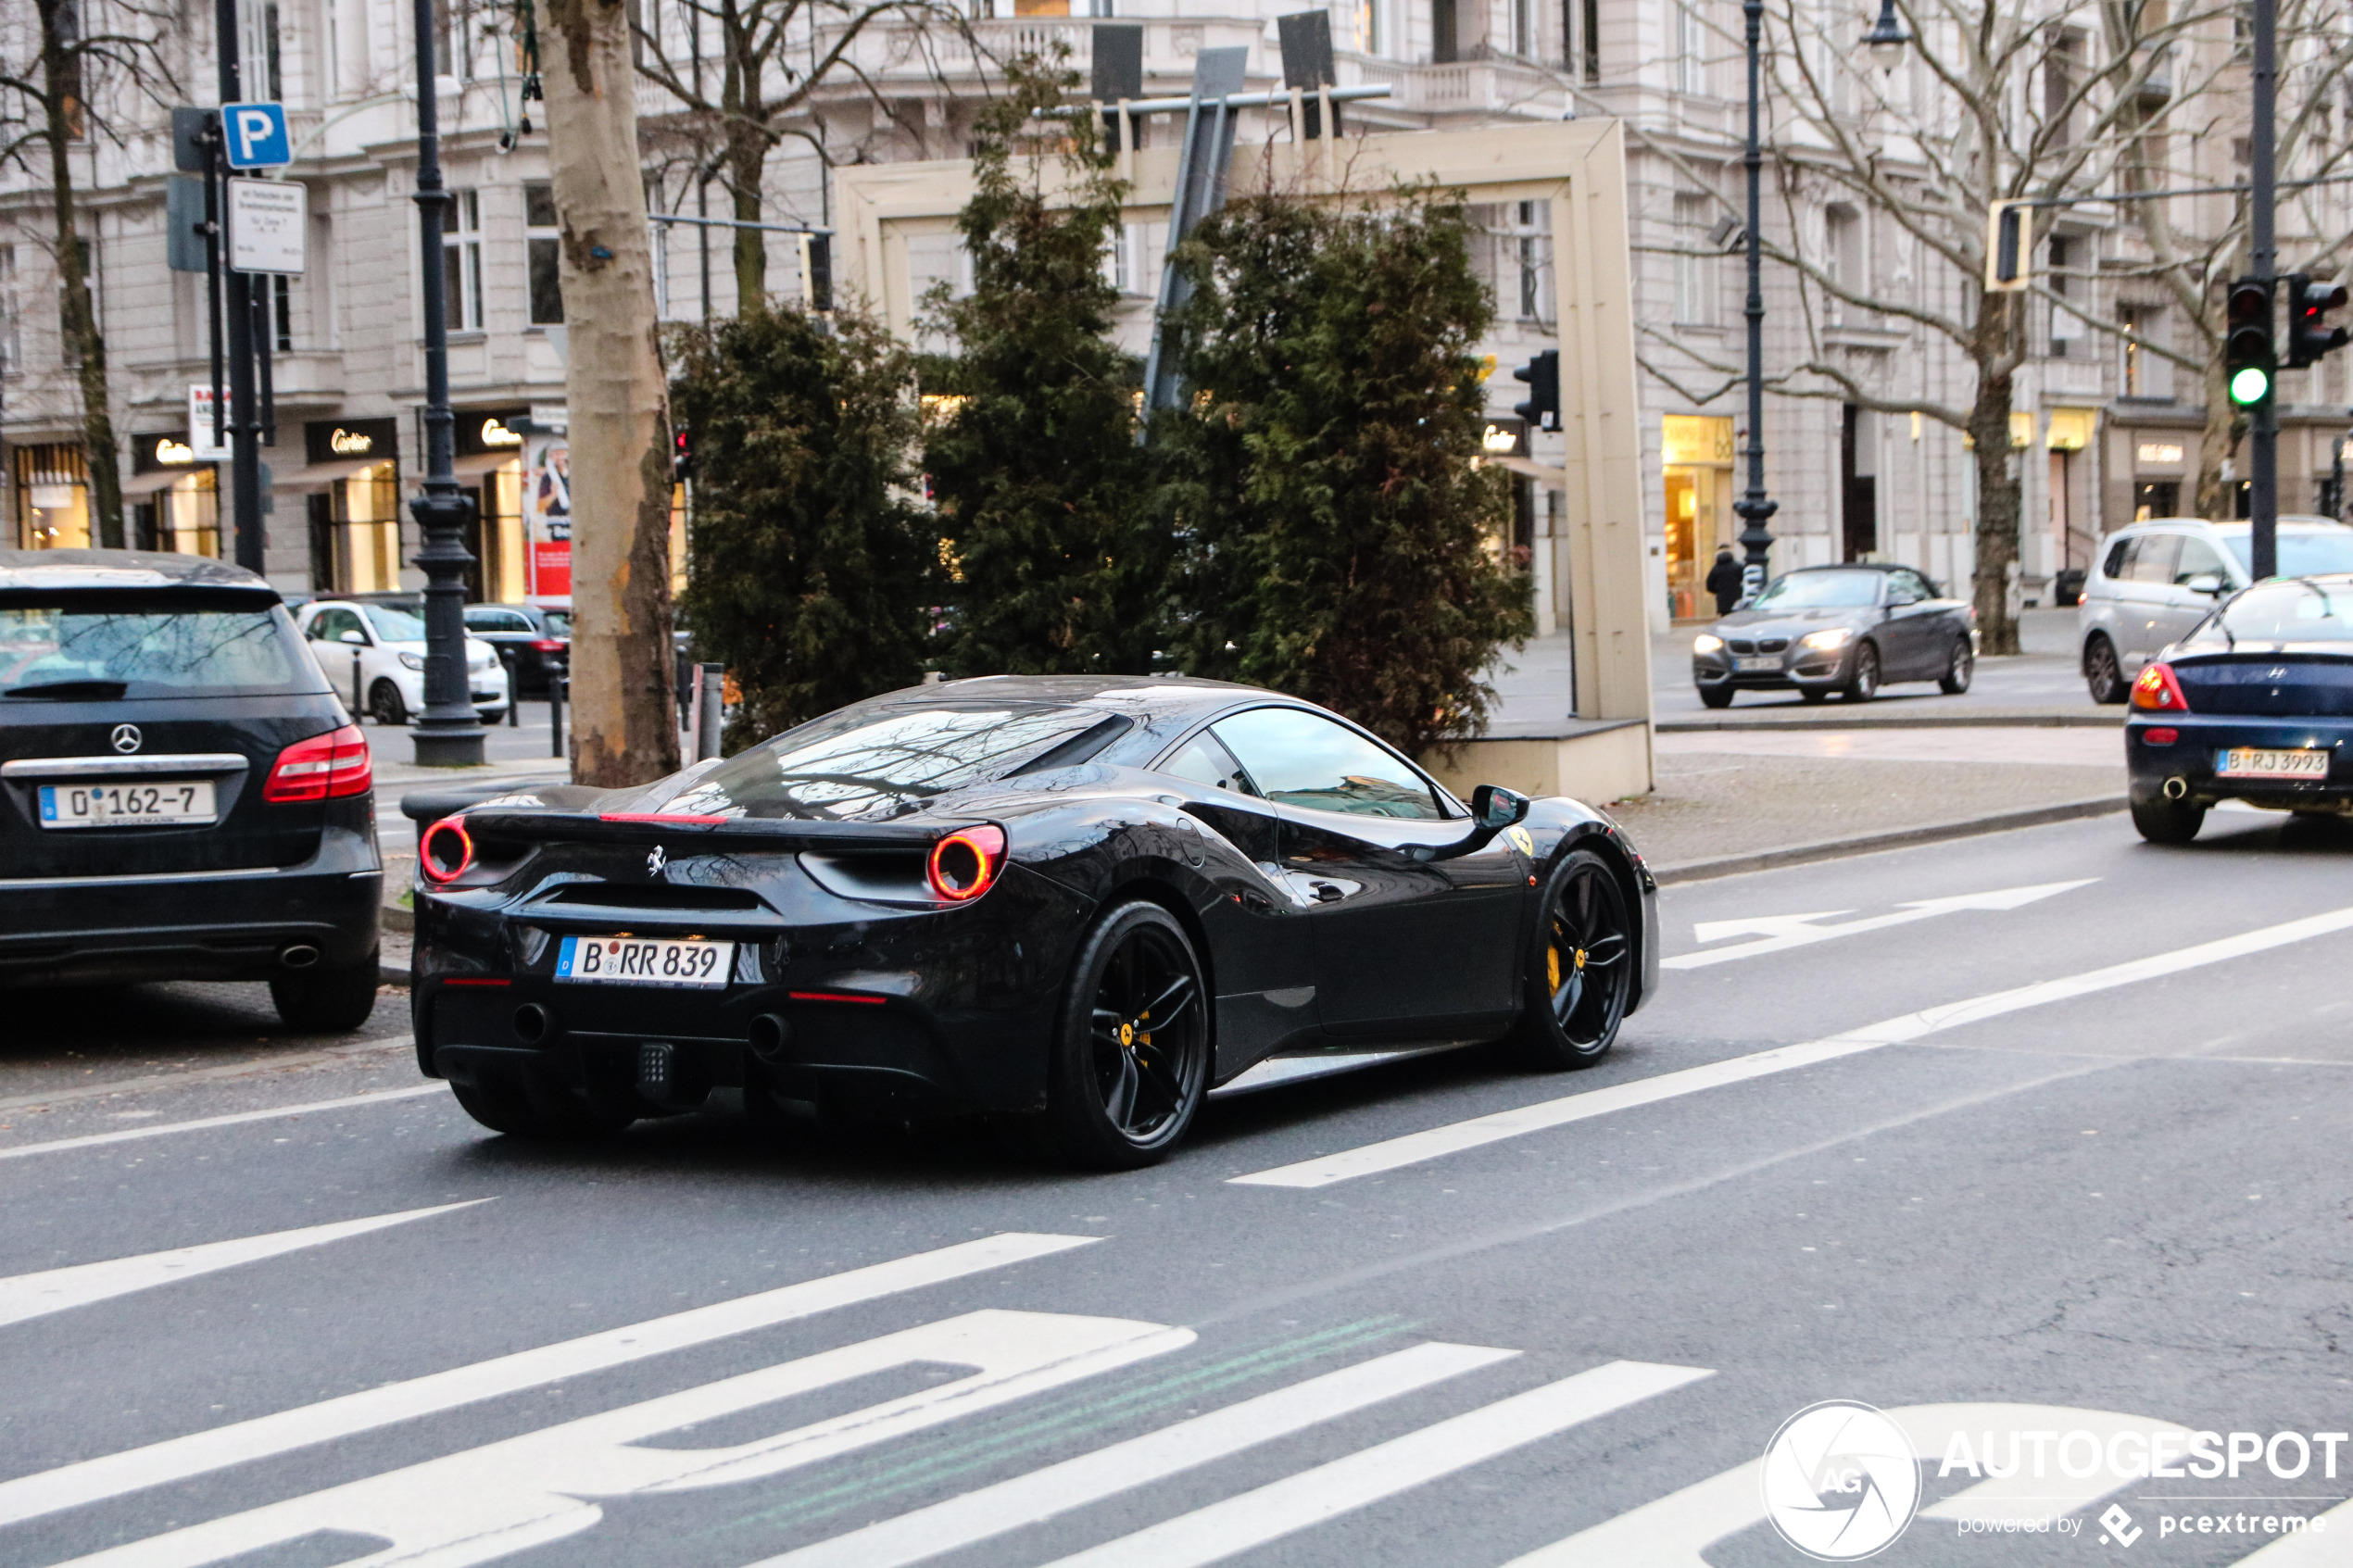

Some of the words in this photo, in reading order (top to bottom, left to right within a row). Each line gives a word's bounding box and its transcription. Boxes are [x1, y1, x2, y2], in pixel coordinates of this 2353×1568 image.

[237, 110, 274, 159] P
[331, 428, 372, 453] Cartier
[2229, 753, 2239, 769] B
[2281, 754, 2324, 771] 3993
[108, 787, 195, 814] 162-7
[583, 942, 602, 972] B
[620, 943, 658, 975] RR
[662, 946, 717, 977] 839
